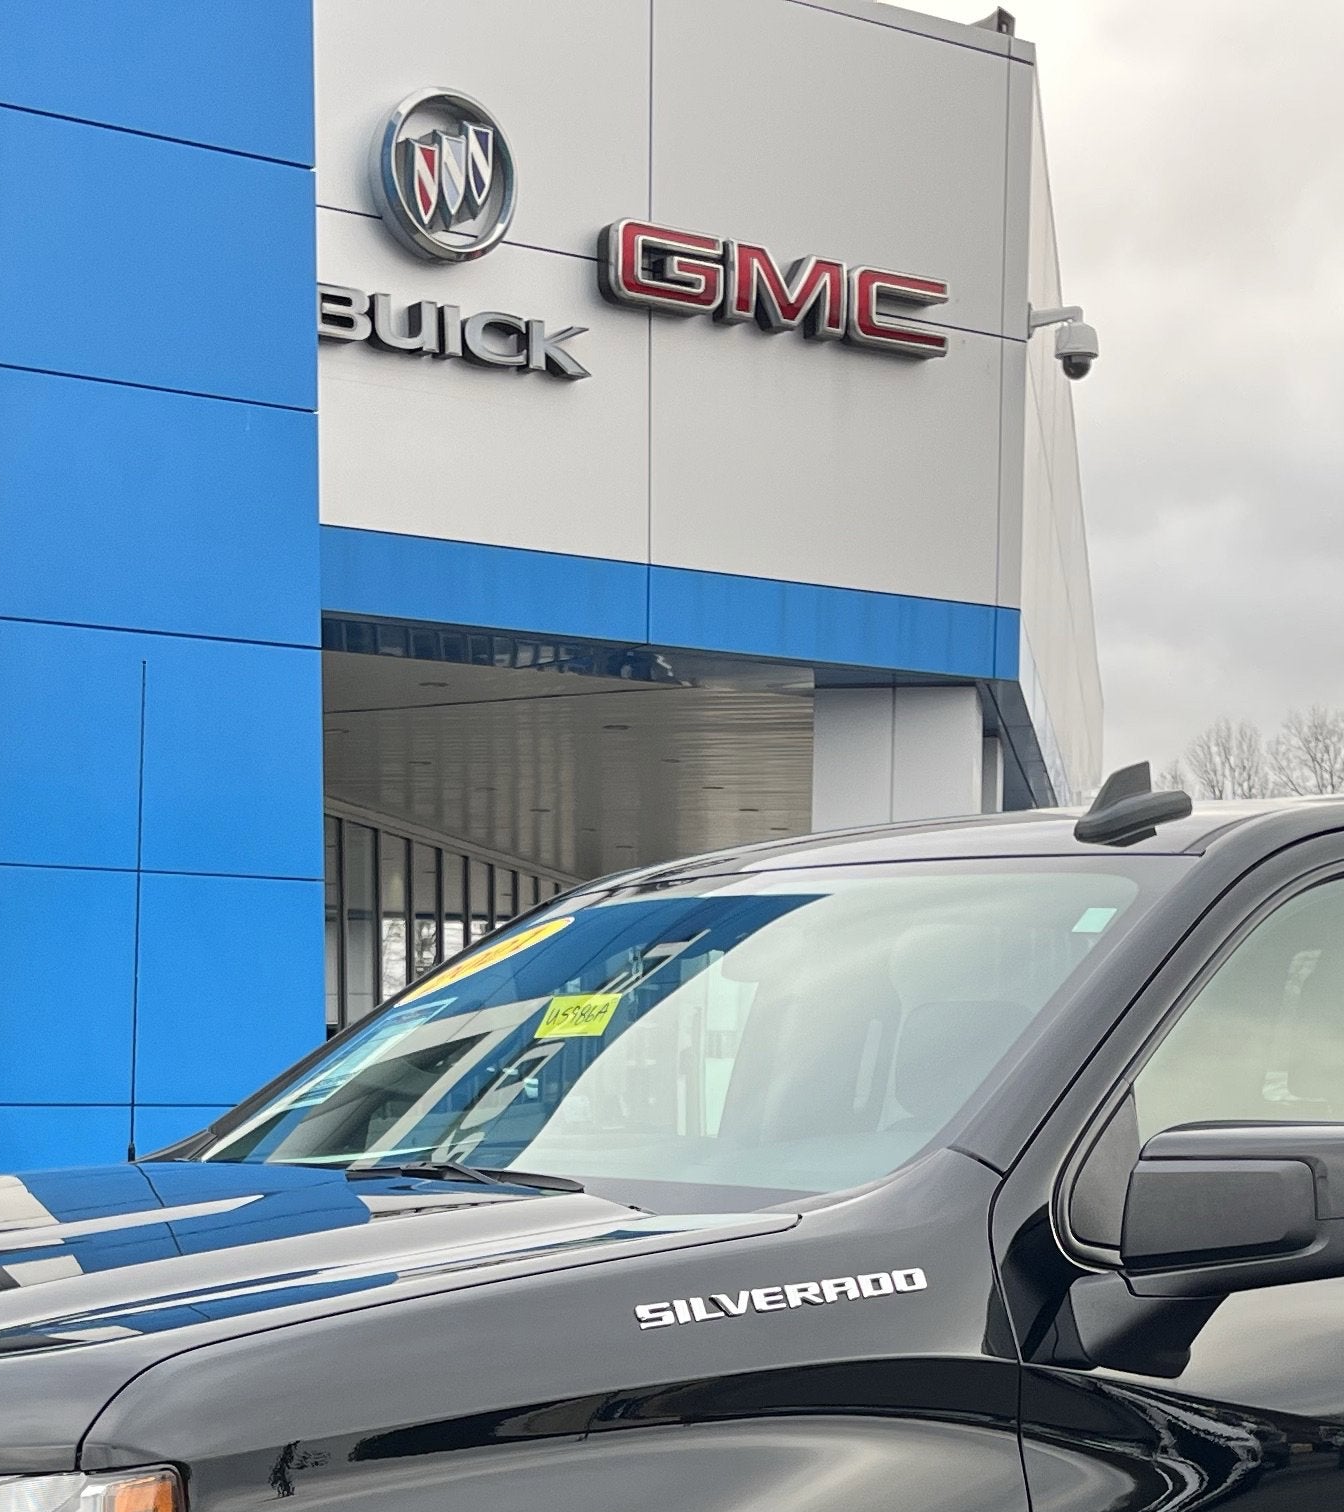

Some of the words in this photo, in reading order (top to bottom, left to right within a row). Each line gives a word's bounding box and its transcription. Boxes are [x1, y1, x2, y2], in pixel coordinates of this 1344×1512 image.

[318, 282, 592, 379] BUICK
[598, 217, 949, 357] GMC
[634, 1267, 928, 1330] SILVERADO
